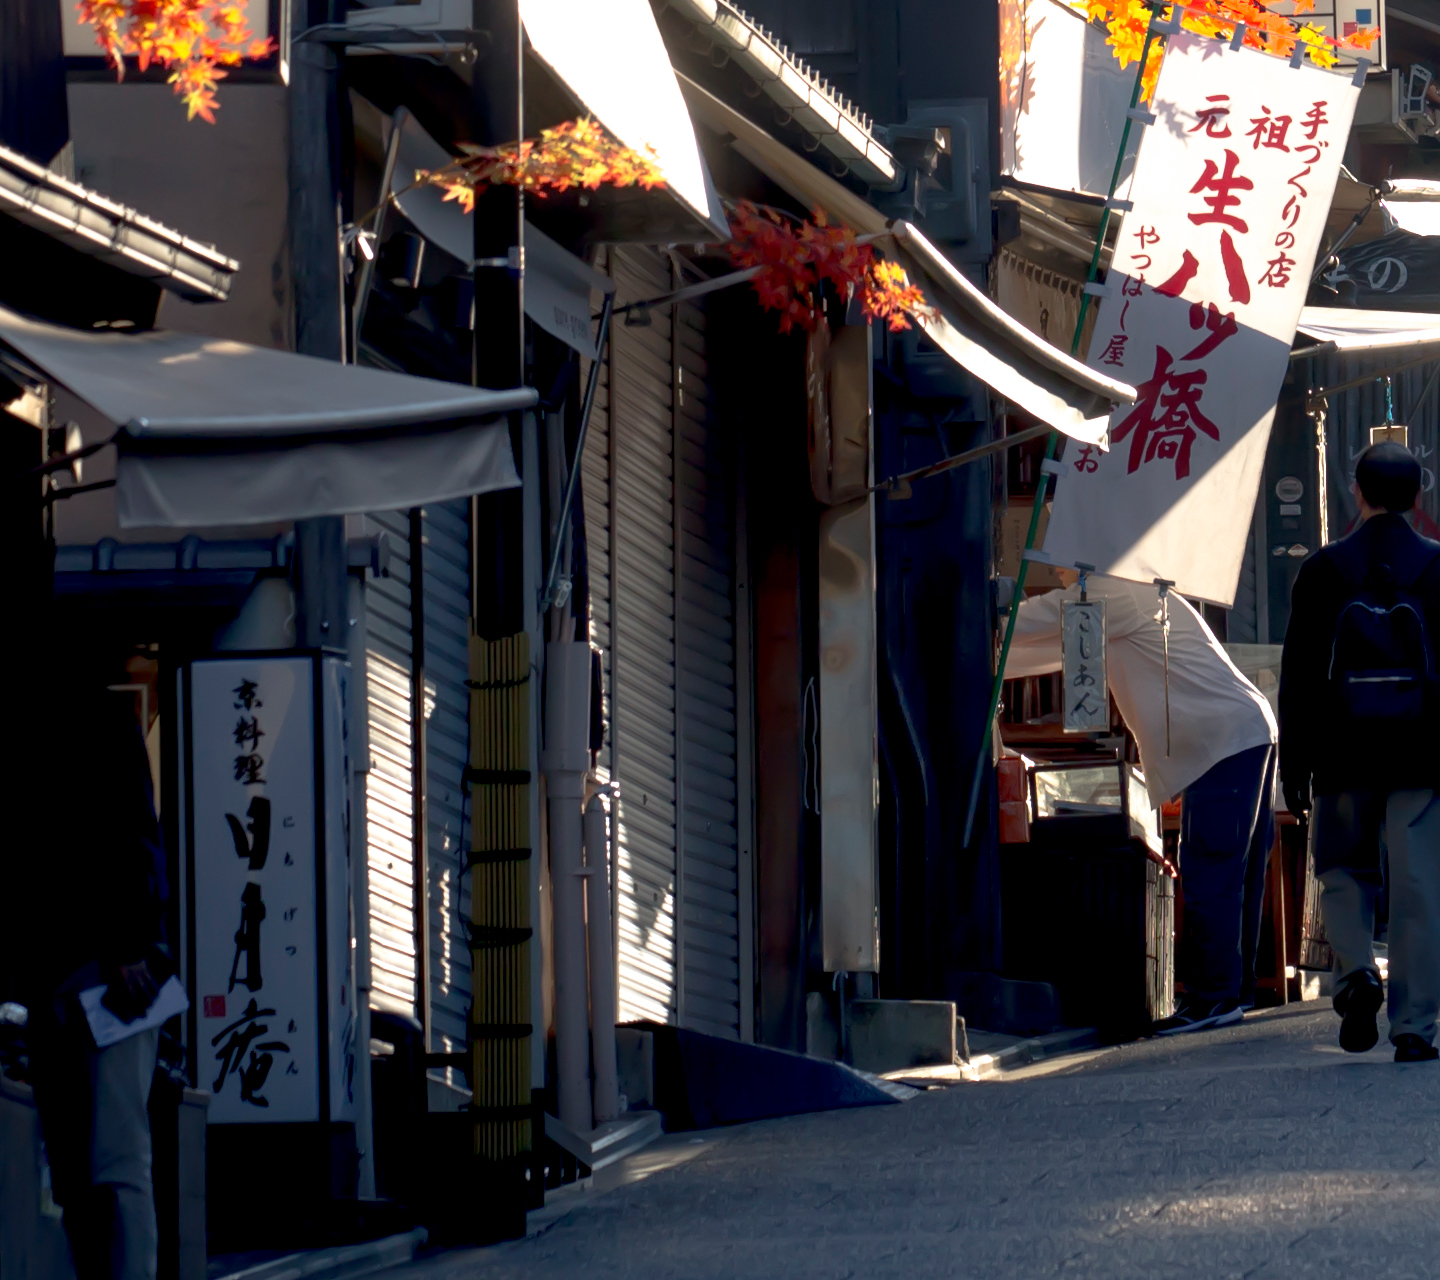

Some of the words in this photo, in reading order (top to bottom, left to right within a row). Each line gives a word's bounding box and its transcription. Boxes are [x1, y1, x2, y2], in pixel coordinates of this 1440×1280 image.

[1188, 94, 1293, 153] 元祖
[1258, 100, 1330, 288] 手づくりの店
[1070, 610, 1099, 717] こしあん
[231, 677, 268, 786] 京料理
